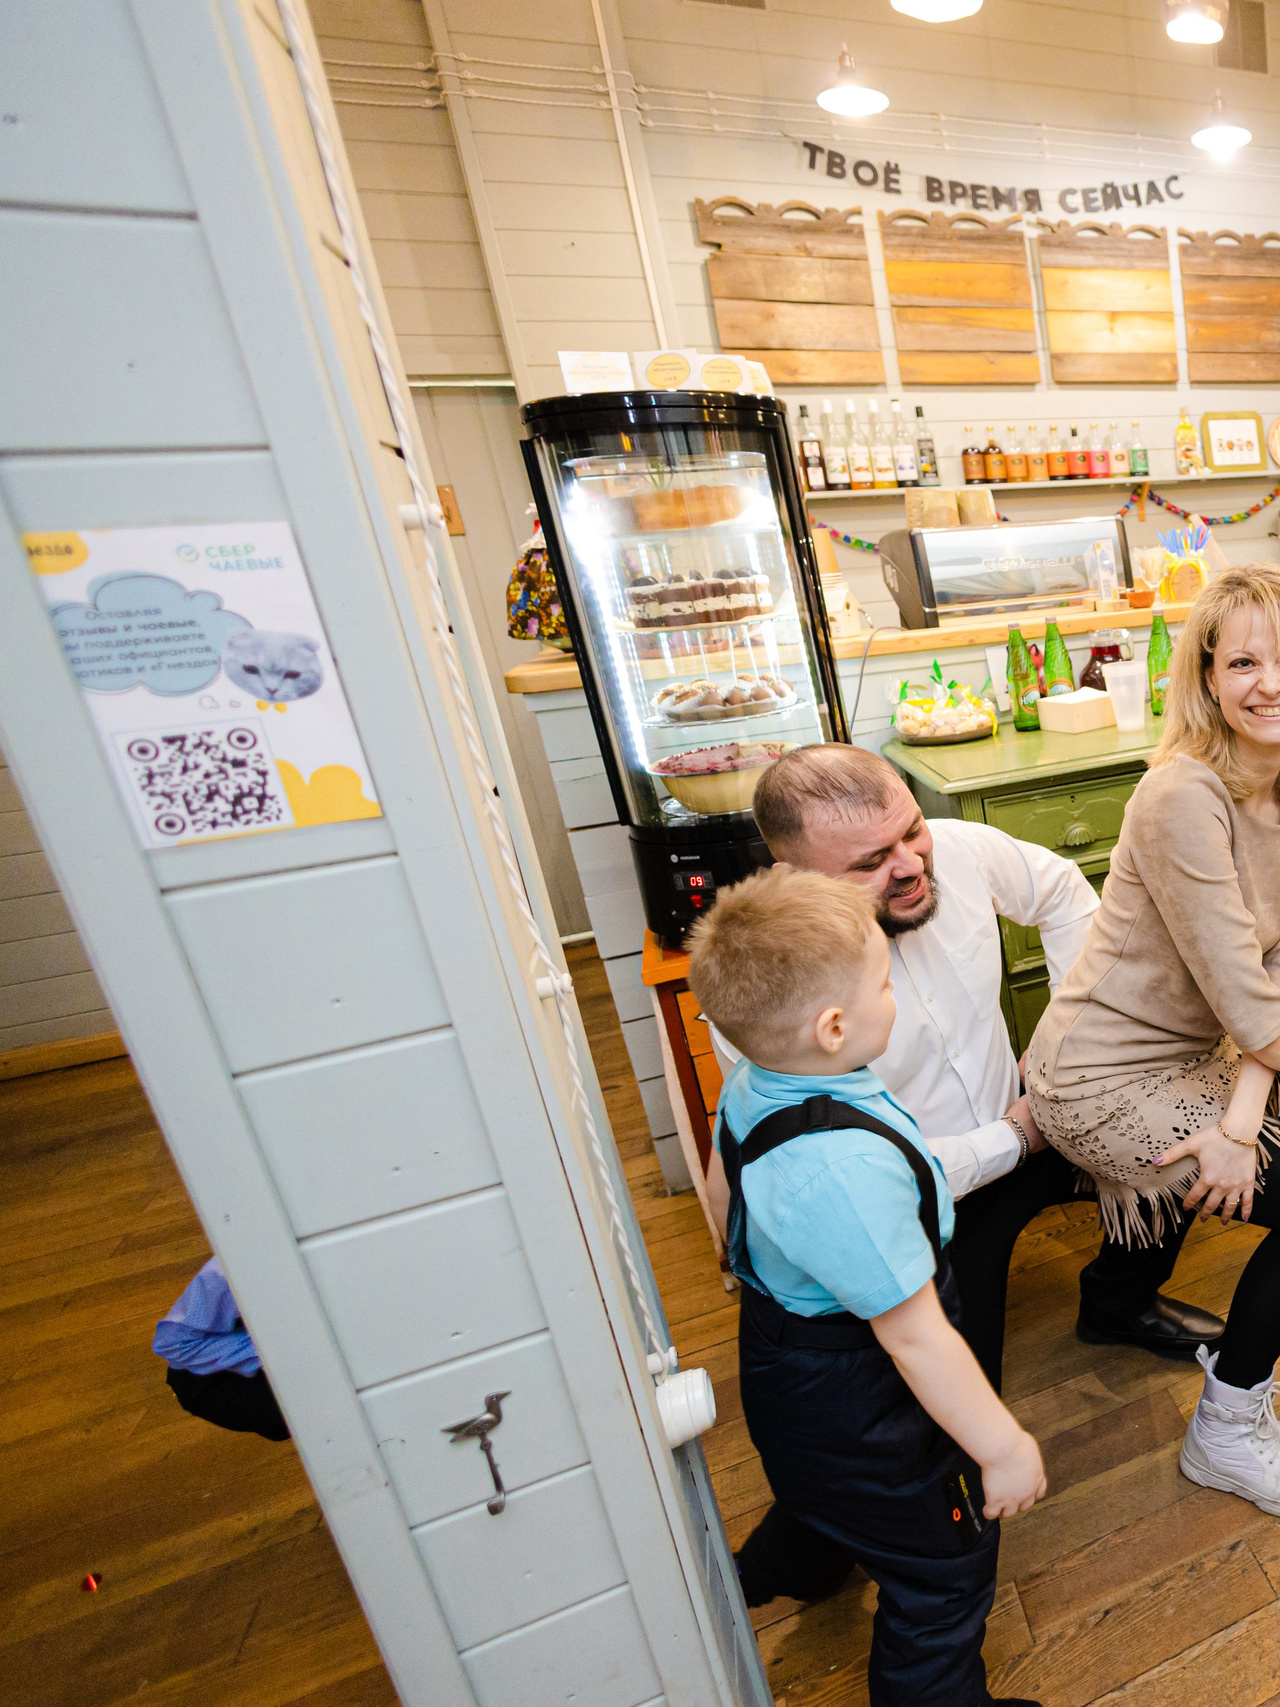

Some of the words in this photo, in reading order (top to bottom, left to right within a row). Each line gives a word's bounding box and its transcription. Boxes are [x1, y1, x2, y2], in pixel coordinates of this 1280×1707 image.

[802, 140, 902, 195] ТВОЁ
[925, 176, 1042, 213] ВРЕМЯ
[1059, 174, 1184, 214] СЕЙЧАС
[205, 544, 255, 558] СБЕР
[209, 557, 284, 572] ЧАЕВЫЕ
[85, 608, 161, 620] Оставляя
[59, 627, 117, 637] отзывы
[84, 633, 206, 648] поддерживаете
[70, 655, 112, 664] аших
[690, 876, 703, 886] 09
